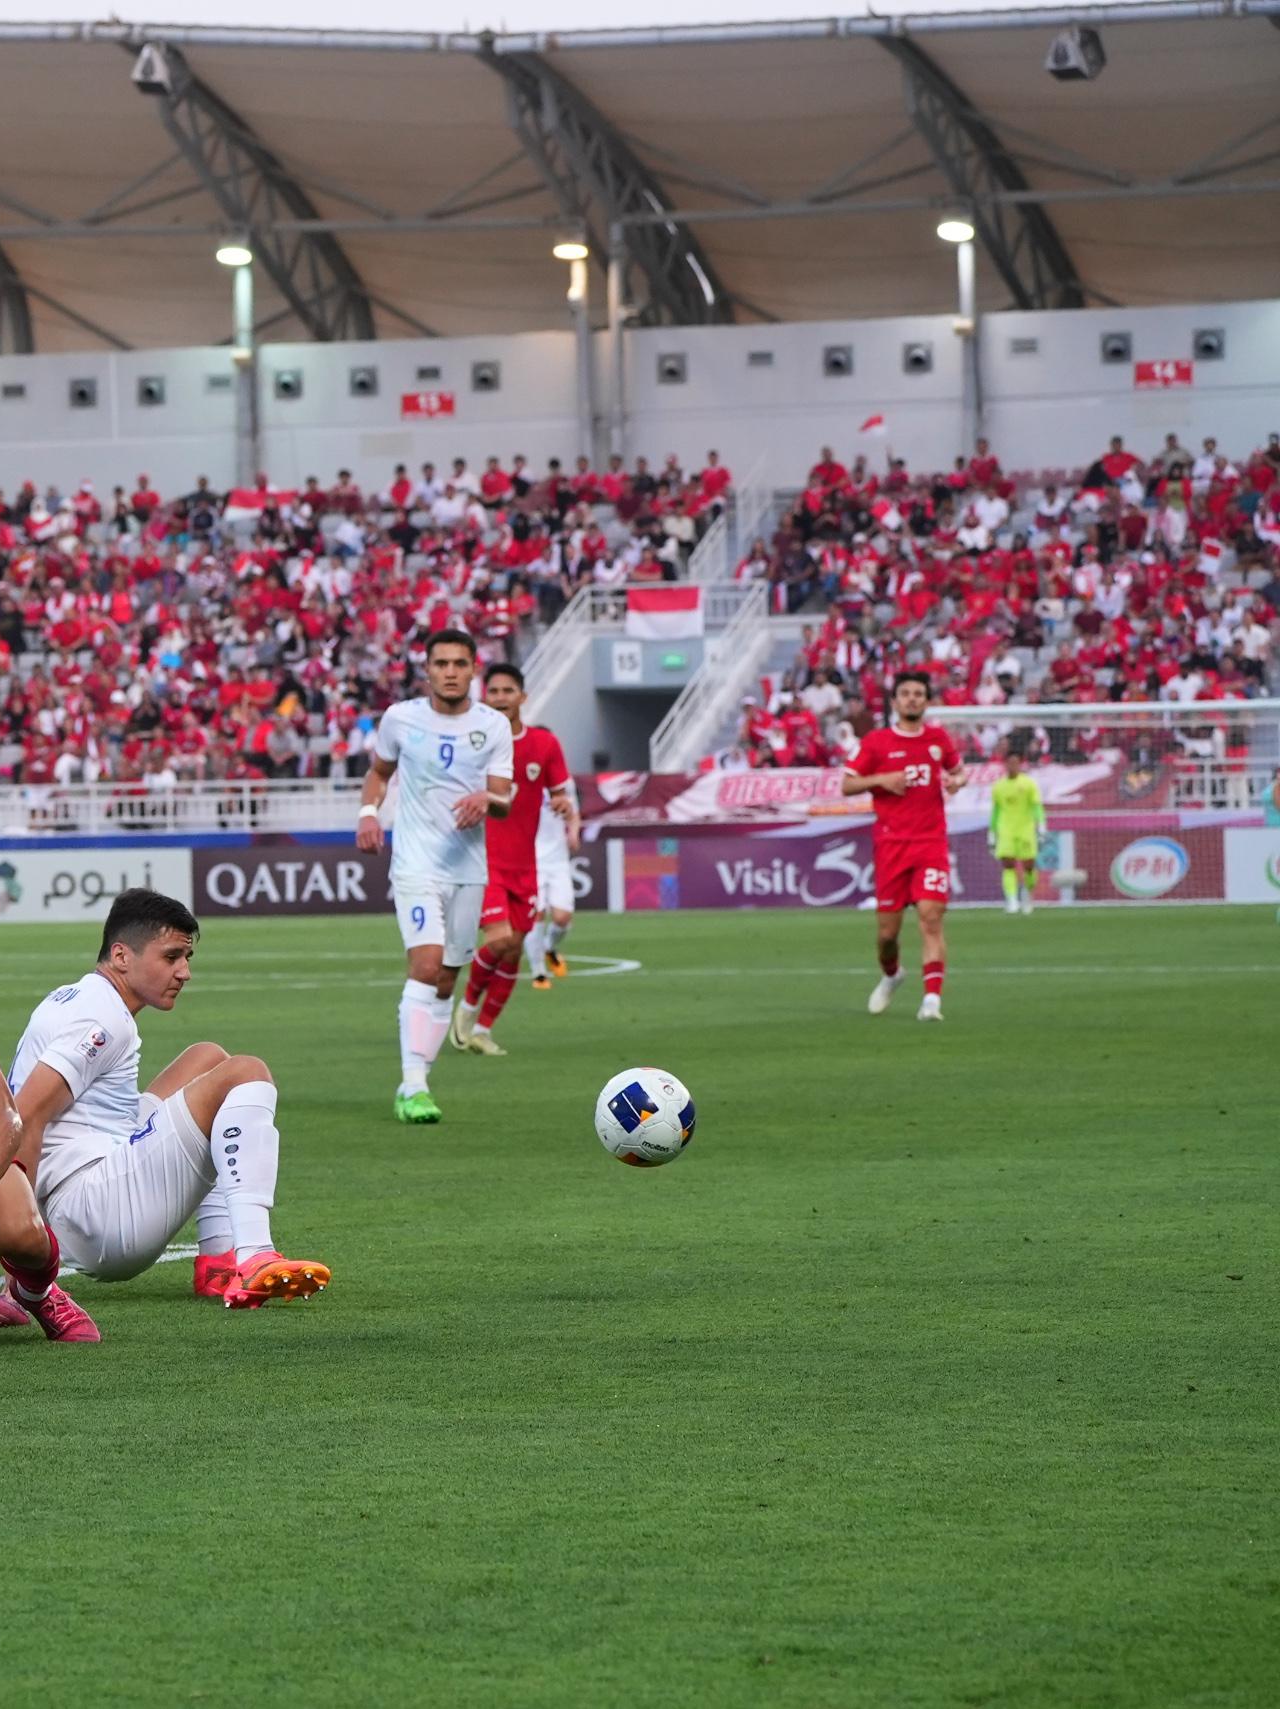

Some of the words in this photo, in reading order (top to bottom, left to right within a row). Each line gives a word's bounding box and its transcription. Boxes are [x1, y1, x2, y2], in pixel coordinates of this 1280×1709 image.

[440, 743, 454, 769] 9
[905, 764, 931, 786] 23
[206, 860, 366, 908] QATAR
[716, 857, 801, 895] Visit
[923, 867, 949, 893] 23
[411, 906, 426, 931] 9
[641, 1141, 670, 1154] molten
